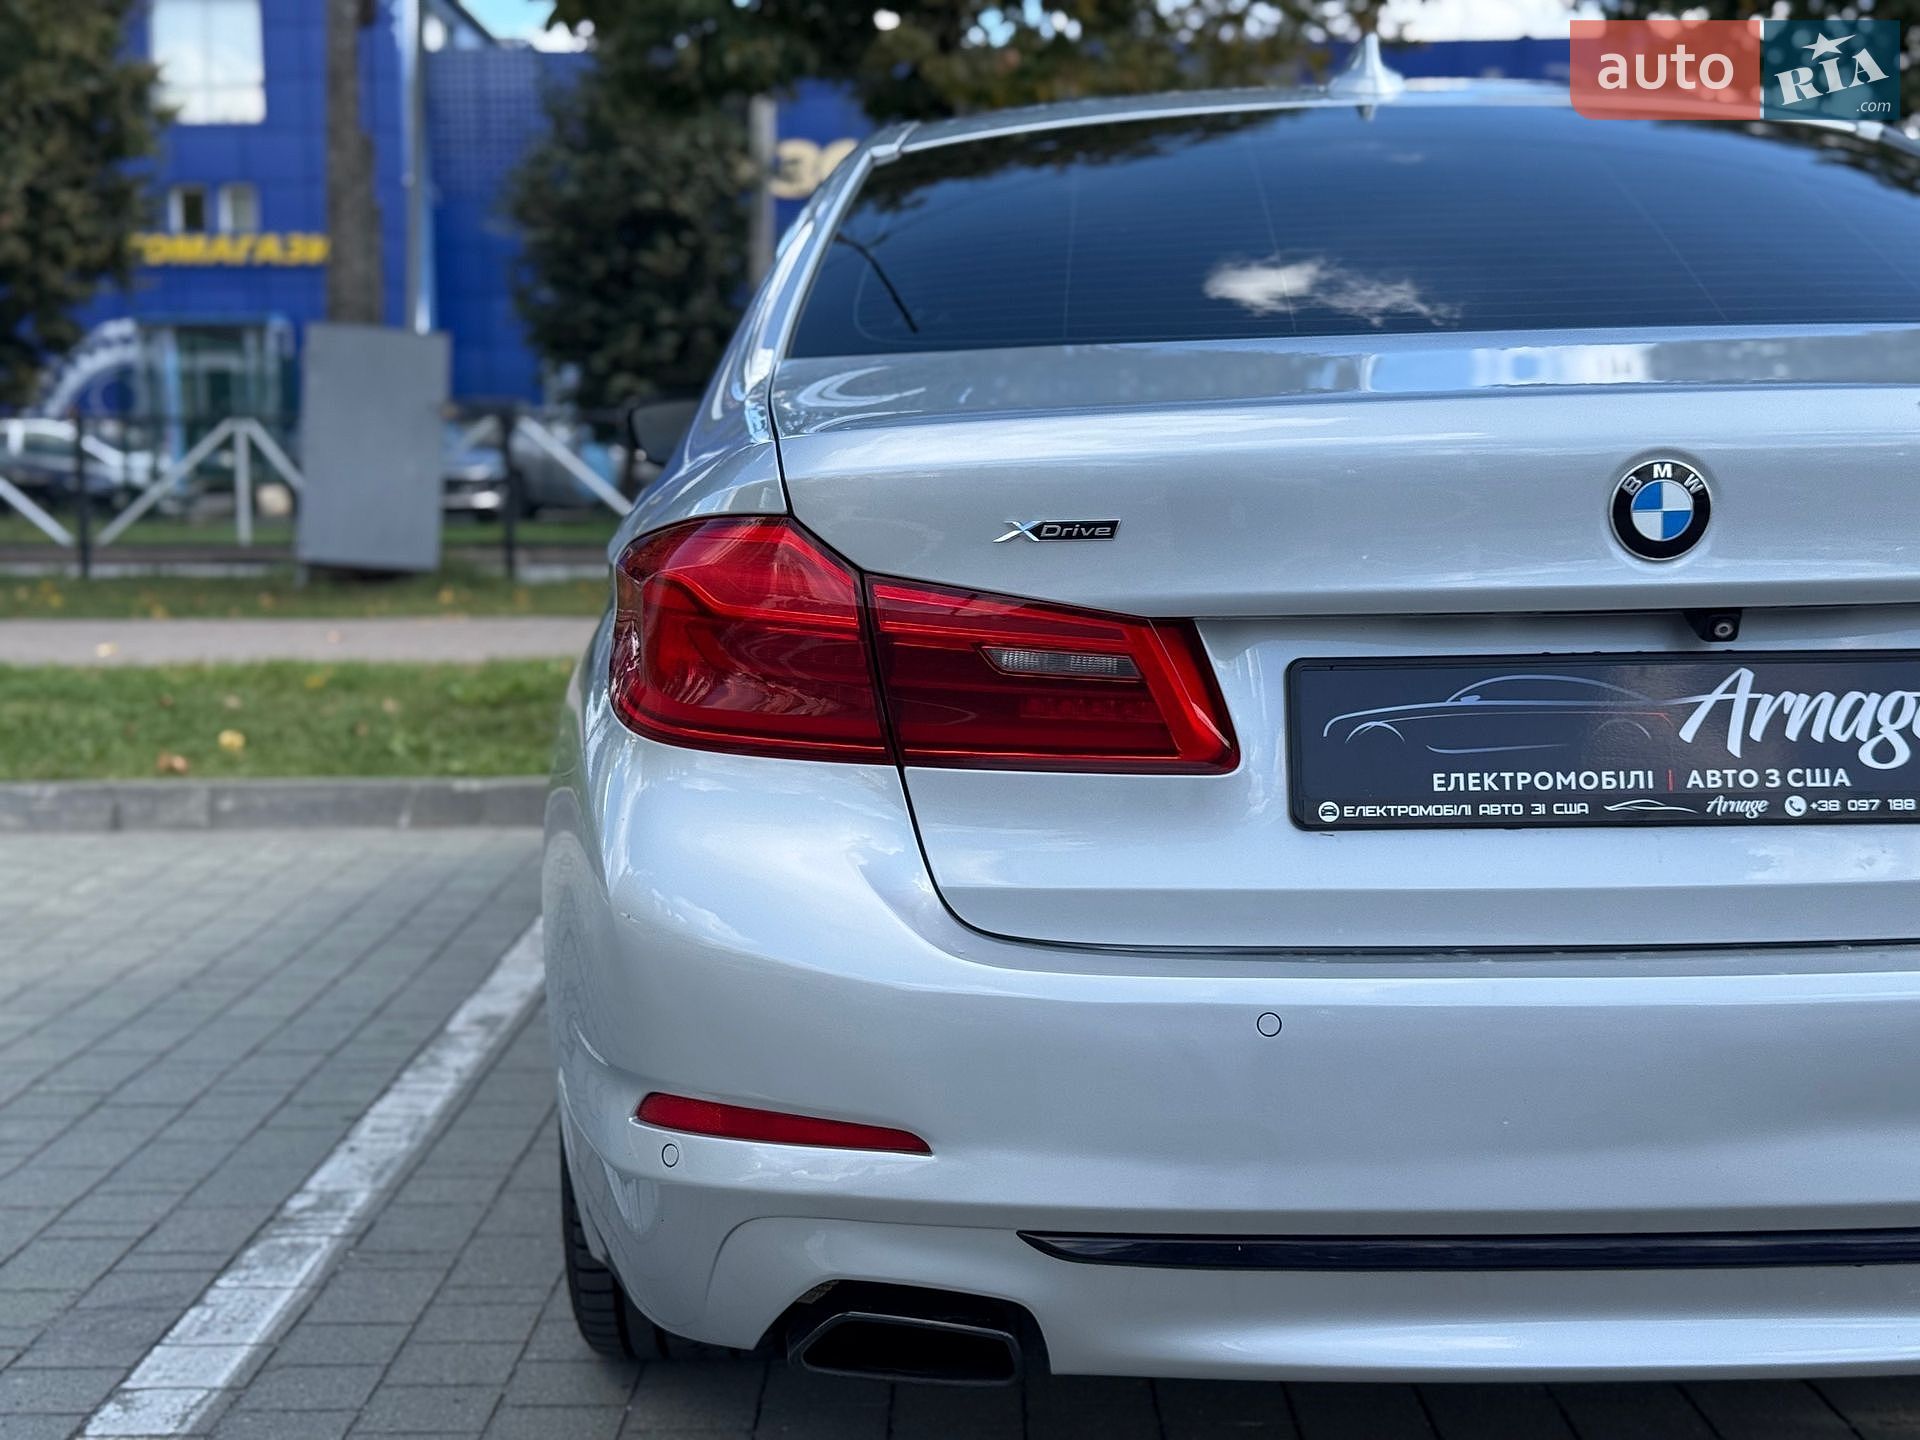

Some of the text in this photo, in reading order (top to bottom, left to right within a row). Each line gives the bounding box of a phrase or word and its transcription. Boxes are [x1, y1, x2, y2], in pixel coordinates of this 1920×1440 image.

[1621, 462, 1705, 497] BMW
[1678, 667, 1920, 770] Arnag
[1432, 767, 1852, 792] ЕЛЕКТРОМОБІЛІ АВТО З США
[1343, 802, 1590, 818] ЕЛЕКТРОМОБІЛІ АВТО ЗІ США
[1705, 794, 1770, 819] Arnage
[1809, 798, 1917, 812] +38 097 188
